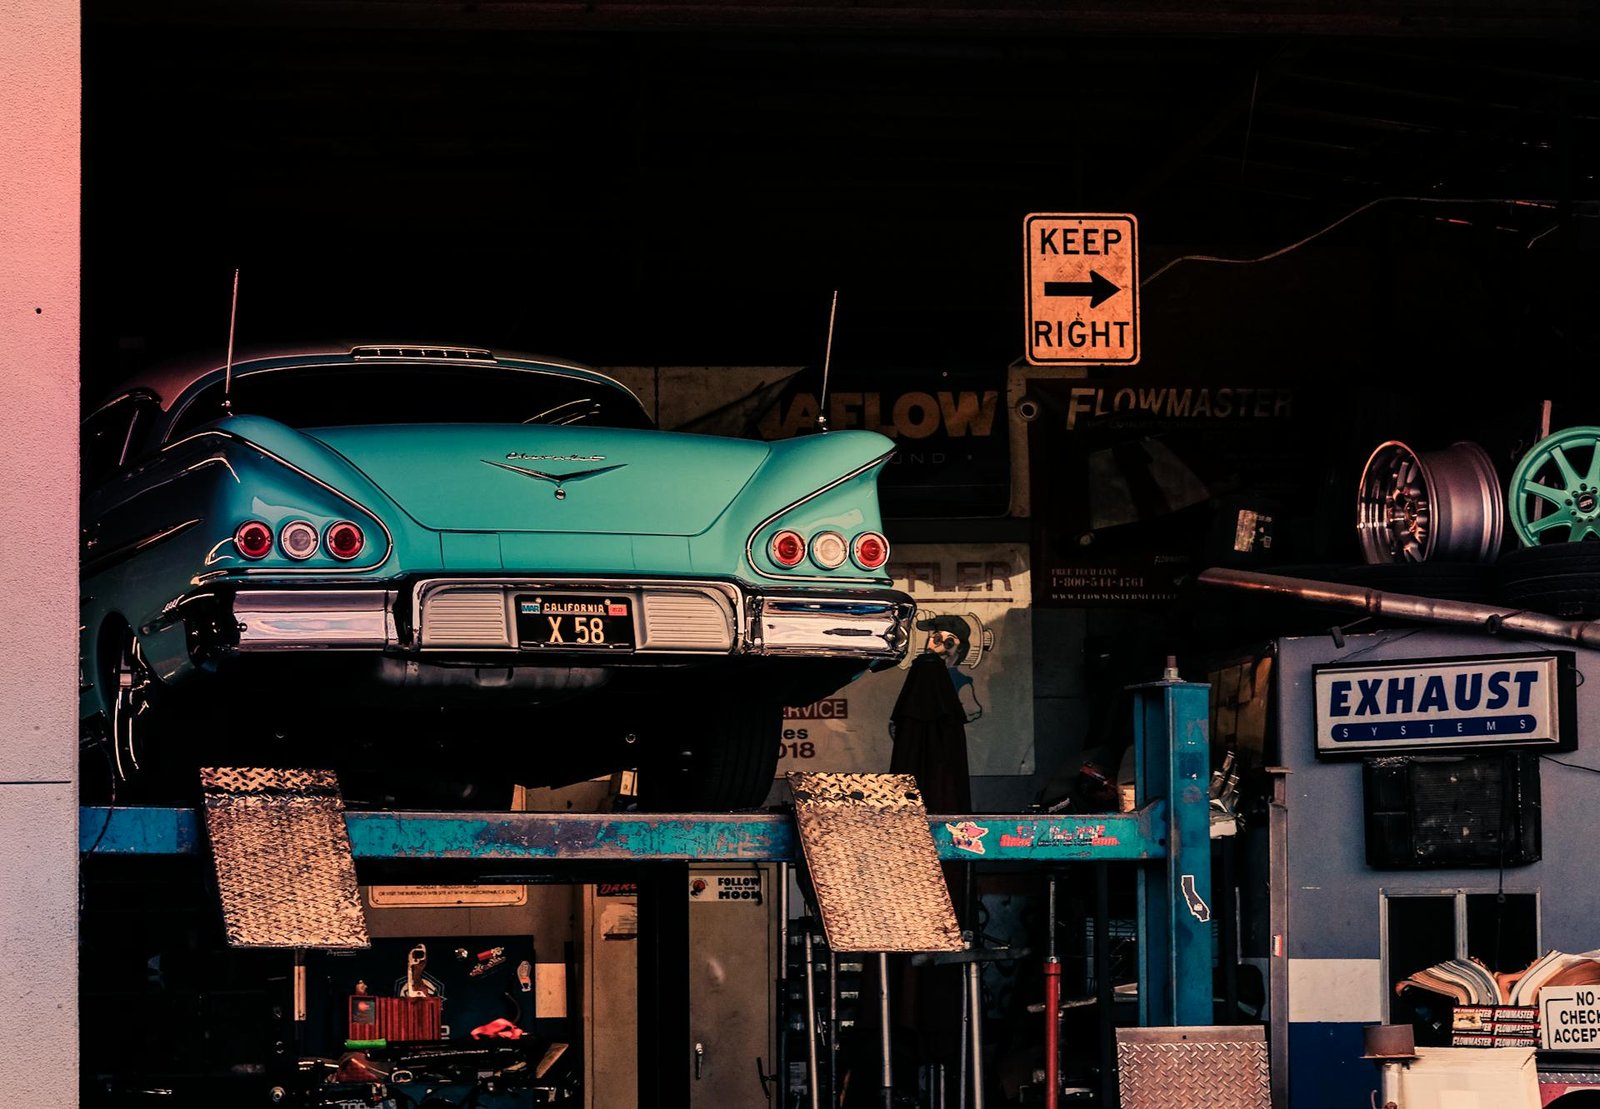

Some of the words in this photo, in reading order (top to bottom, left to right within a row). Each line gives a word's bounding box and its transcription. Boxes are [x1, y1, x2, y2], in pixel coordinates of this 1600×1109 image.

[1040, 228, 1123, 255] KEEP
[1034, 320, 1130, 348] RIGHT
[1065, 387, 1293, 431] FLOWMASTER
[543, 602, 605, 614] CALIFORNIA
[548, 616, 563, 644] X
[574, 616, 605, 645] 58
[1329, 671, 1539, 717] EXHAUST
[1342, 719, 1527, 739] SYSTEMS
[718, 877, 760, 886] FOLLOW
[718, 891, 760, 900] MOON
[1576, 991, 1595, 1006] NO
[1554, 1027, 1600, 1043] ACCEP
